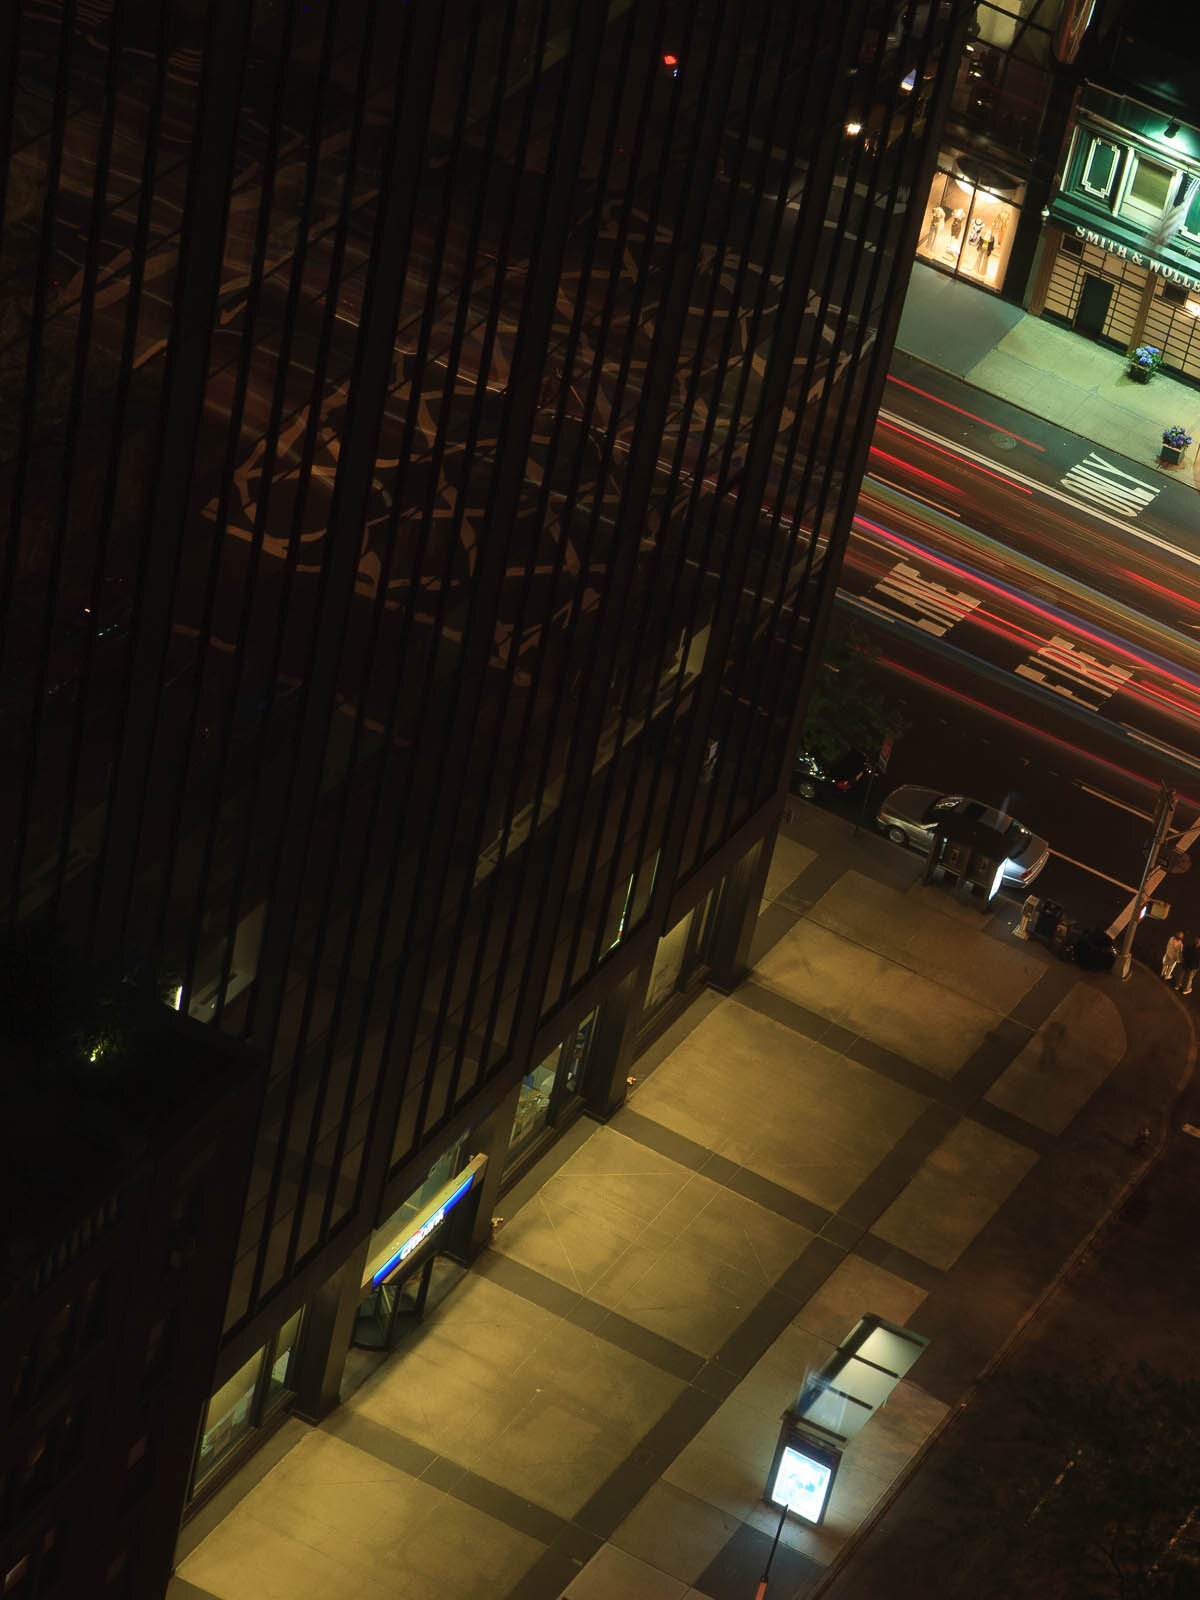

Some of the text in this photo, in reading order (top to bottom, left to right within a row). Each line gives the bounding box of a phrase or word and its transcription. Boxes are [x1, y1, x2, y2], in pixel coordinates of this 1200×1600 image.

[1075, 226, 1127, 259] SMITH
[1132, 252, 1144, 266] &
[1060, 452, 1161, 517] ONLY
